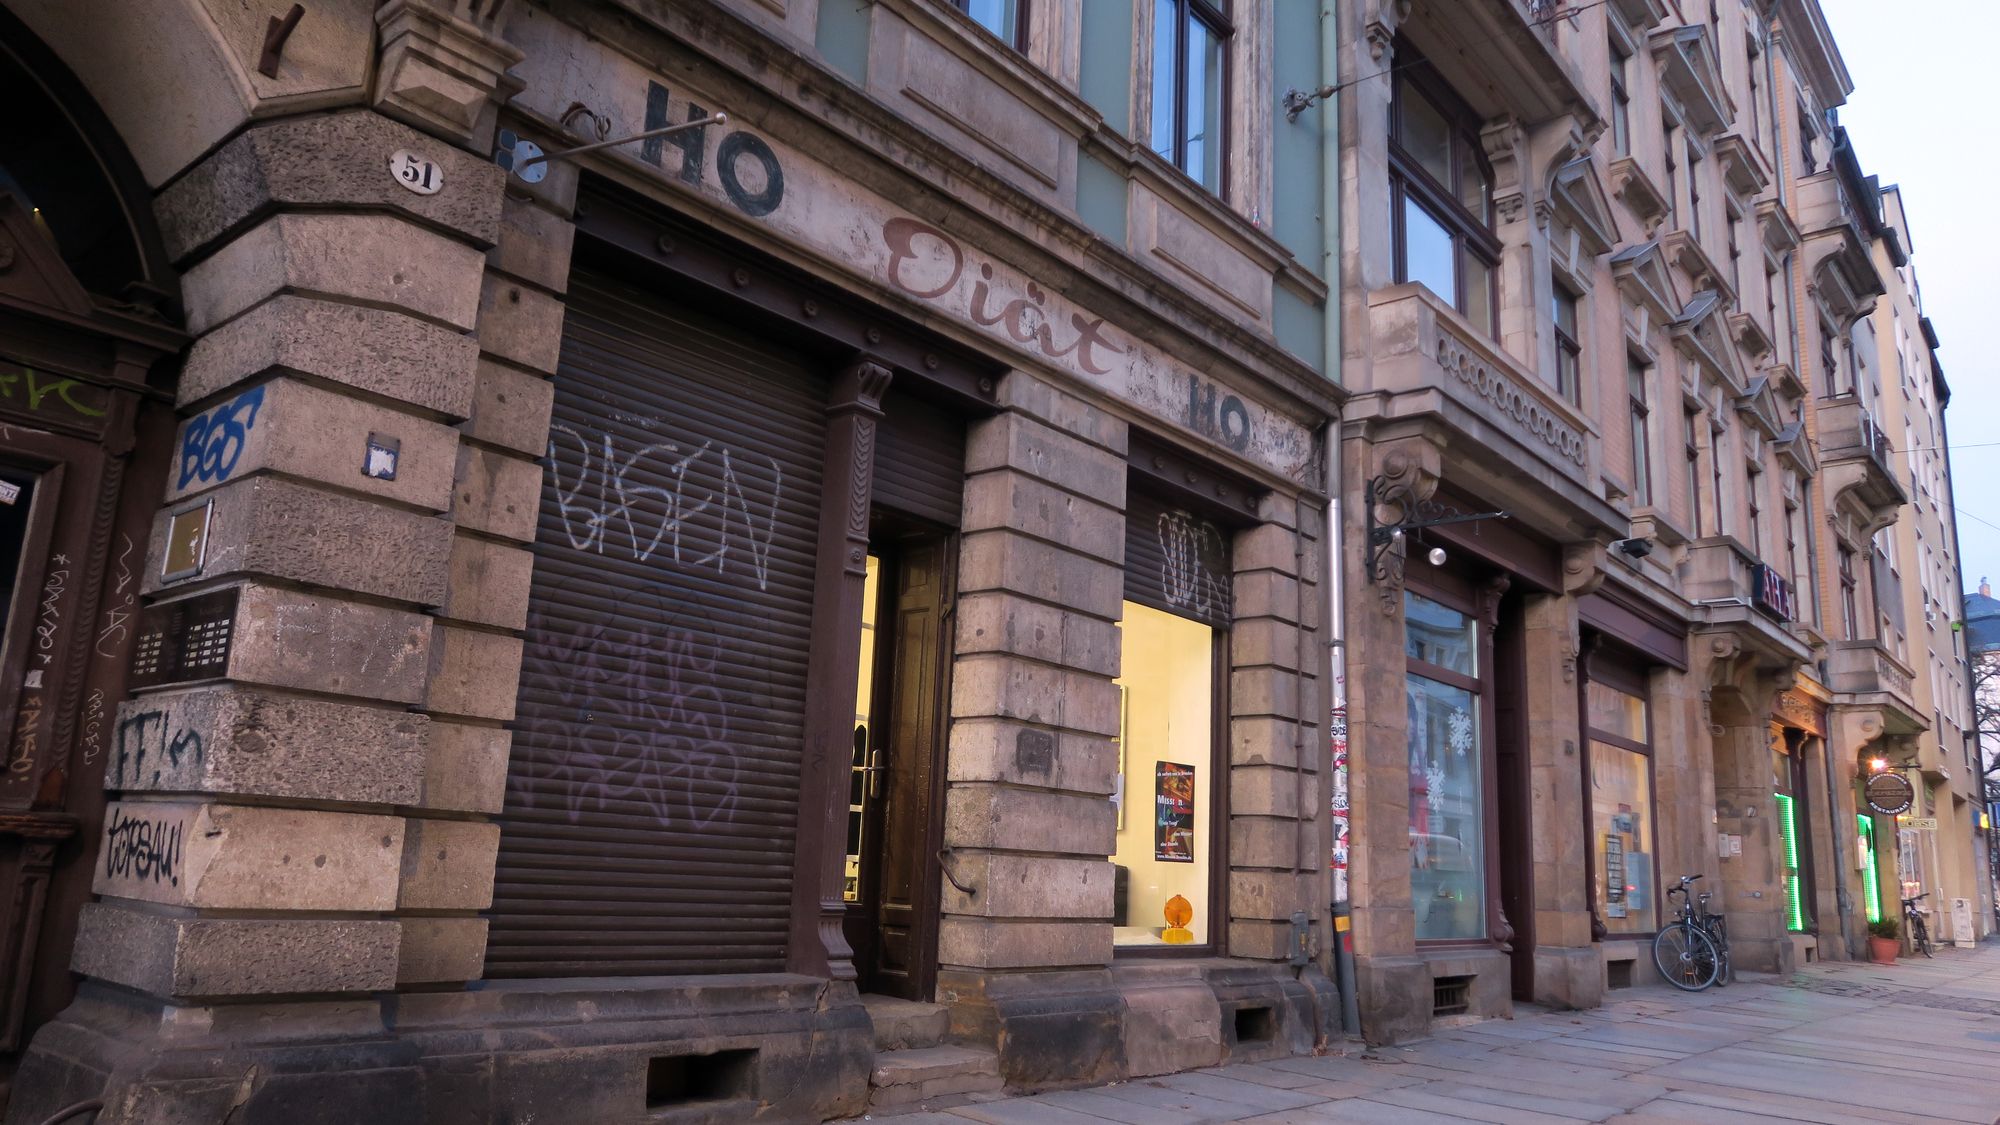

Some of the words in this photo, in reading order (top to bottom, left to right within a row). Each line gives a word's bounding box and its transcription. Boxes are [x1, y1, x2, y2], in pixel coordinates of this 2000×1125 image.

[402, 155, 432, 190] 51
[640, 79, 785, 217] HO
[882, 216, 1125, 375] Diät
[1188, 373, 1251, 454] HO
[1157, 794, 1183, 806] Missin
[1869, 800, 1910, 814] RESTAURANT
